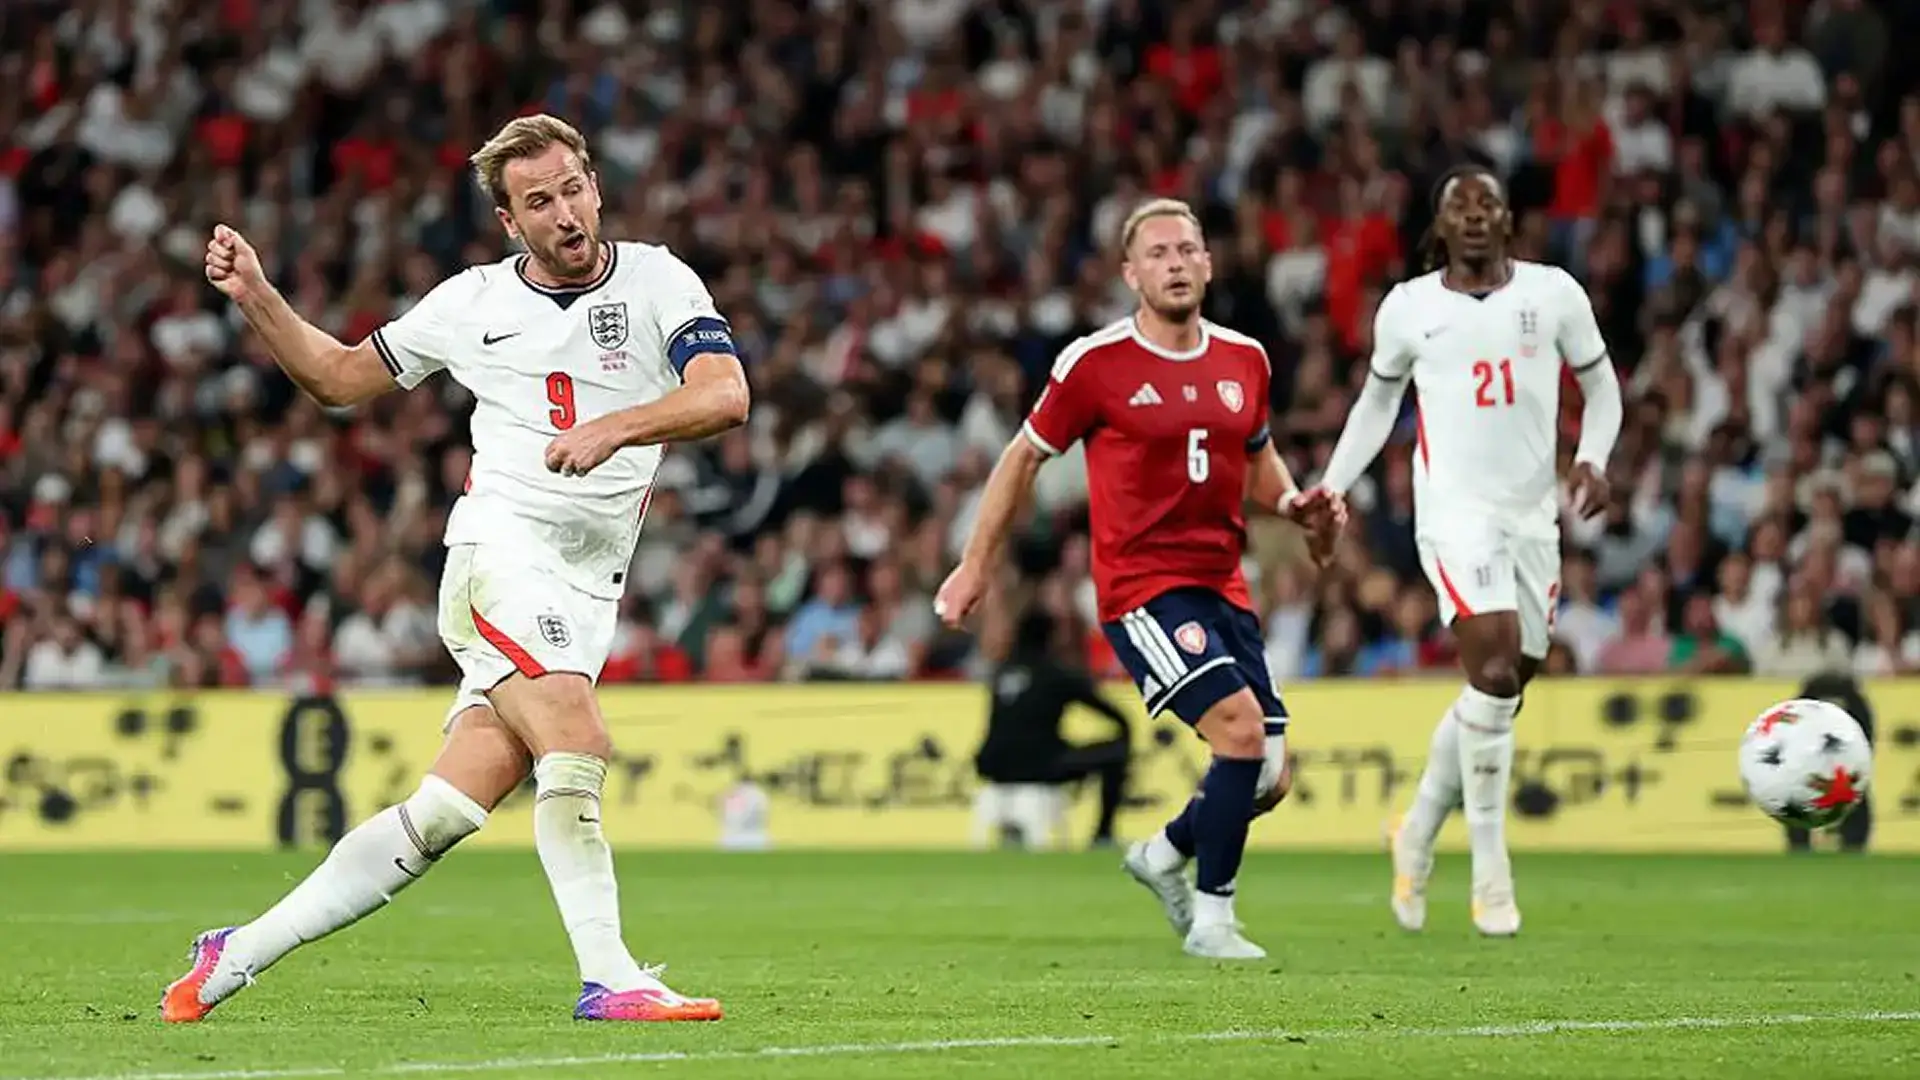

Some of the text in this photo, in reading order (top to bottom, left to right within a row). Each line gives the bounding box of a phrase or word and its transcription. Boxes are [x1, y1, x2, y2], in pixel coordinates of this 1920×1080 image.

[545, 371, 576, 430] 9
[1472, 359, 1515, 406] 21
[1188, 429, 1208, 482] 6
